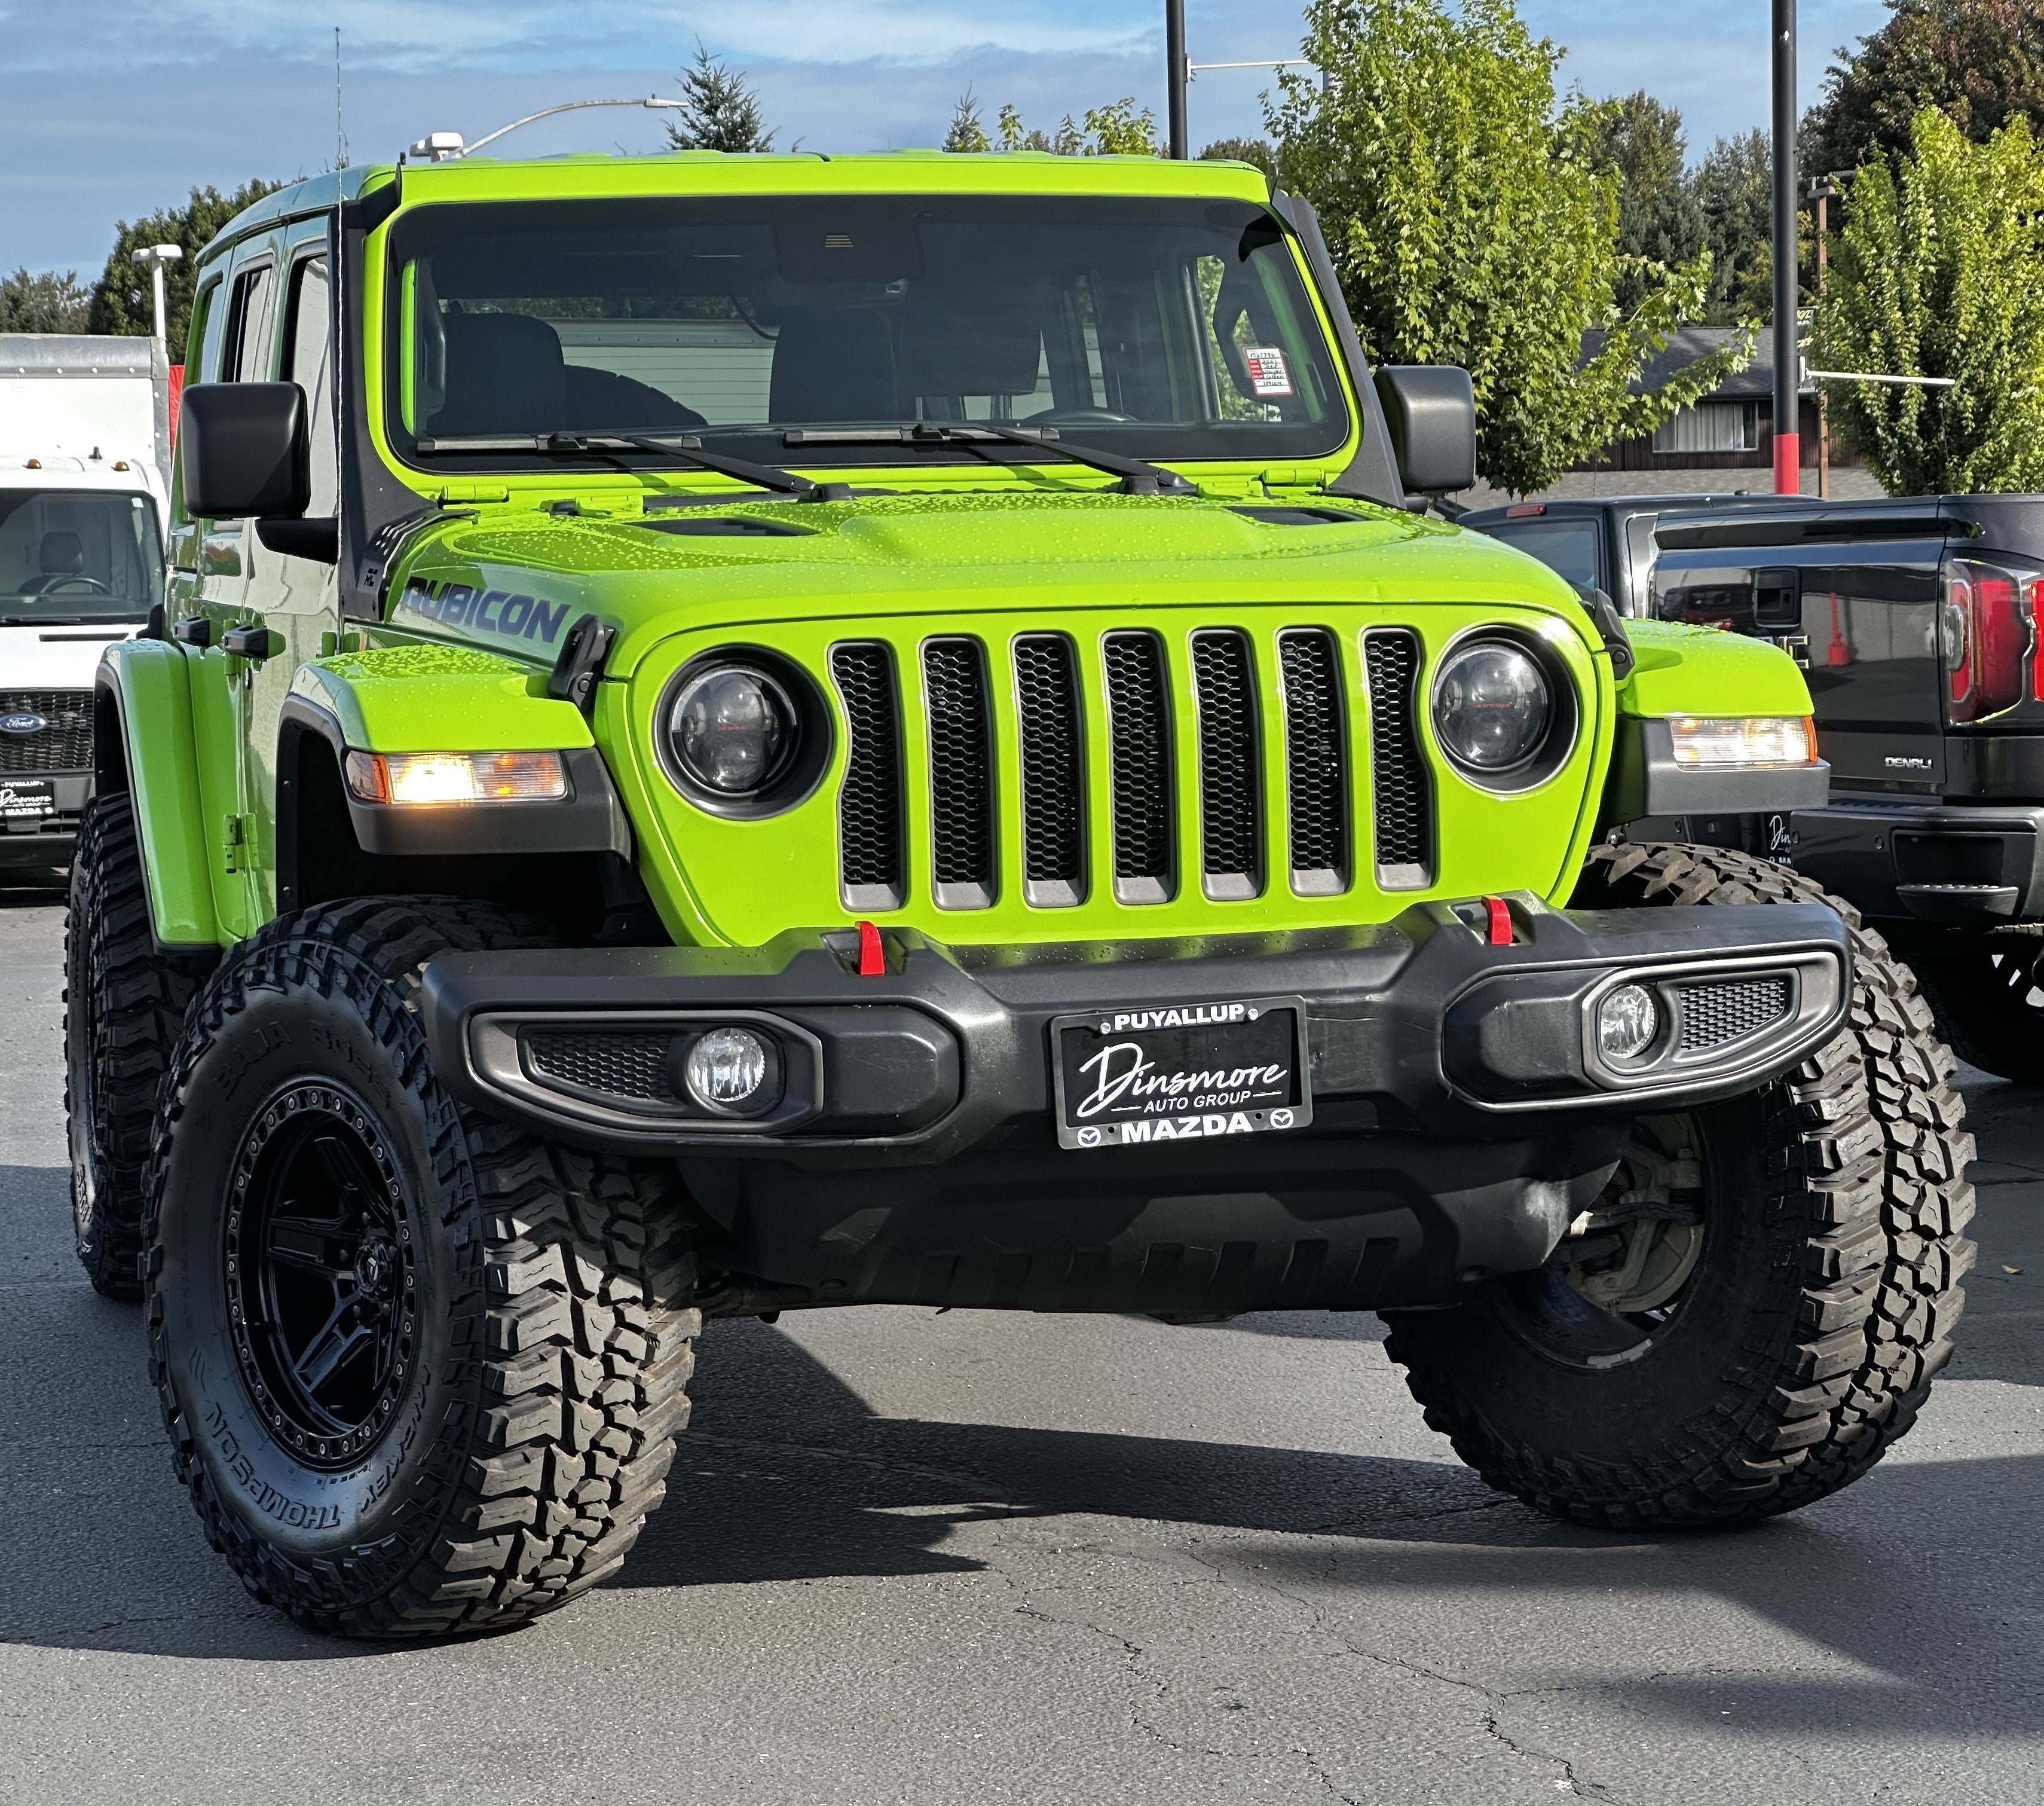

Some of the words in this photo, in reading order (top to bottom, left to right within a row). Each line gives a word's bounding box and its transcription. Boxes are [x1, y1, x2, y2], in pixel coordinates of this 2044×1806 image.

[399, 576, 571, 643] RUBICON
[6, 717, 34, 728] Ford
[1885, 756, 1932, 769] DENALI
[1769, 815, 1791, 850] Din
[1779, 856, 1792, 864] MA
[1114, 1004, 1245, 1031] PUYALLUP
[1076, 1042, 1287, 1117] Dinsmore
[1143, 1096, 1189, 1114] AUTO
[1193, 1090, 1252, 1107] GROUP
[1121, 1111, 1253, 1144] MAZDA
[205, 1401, 341, 1530] THOMPSON
